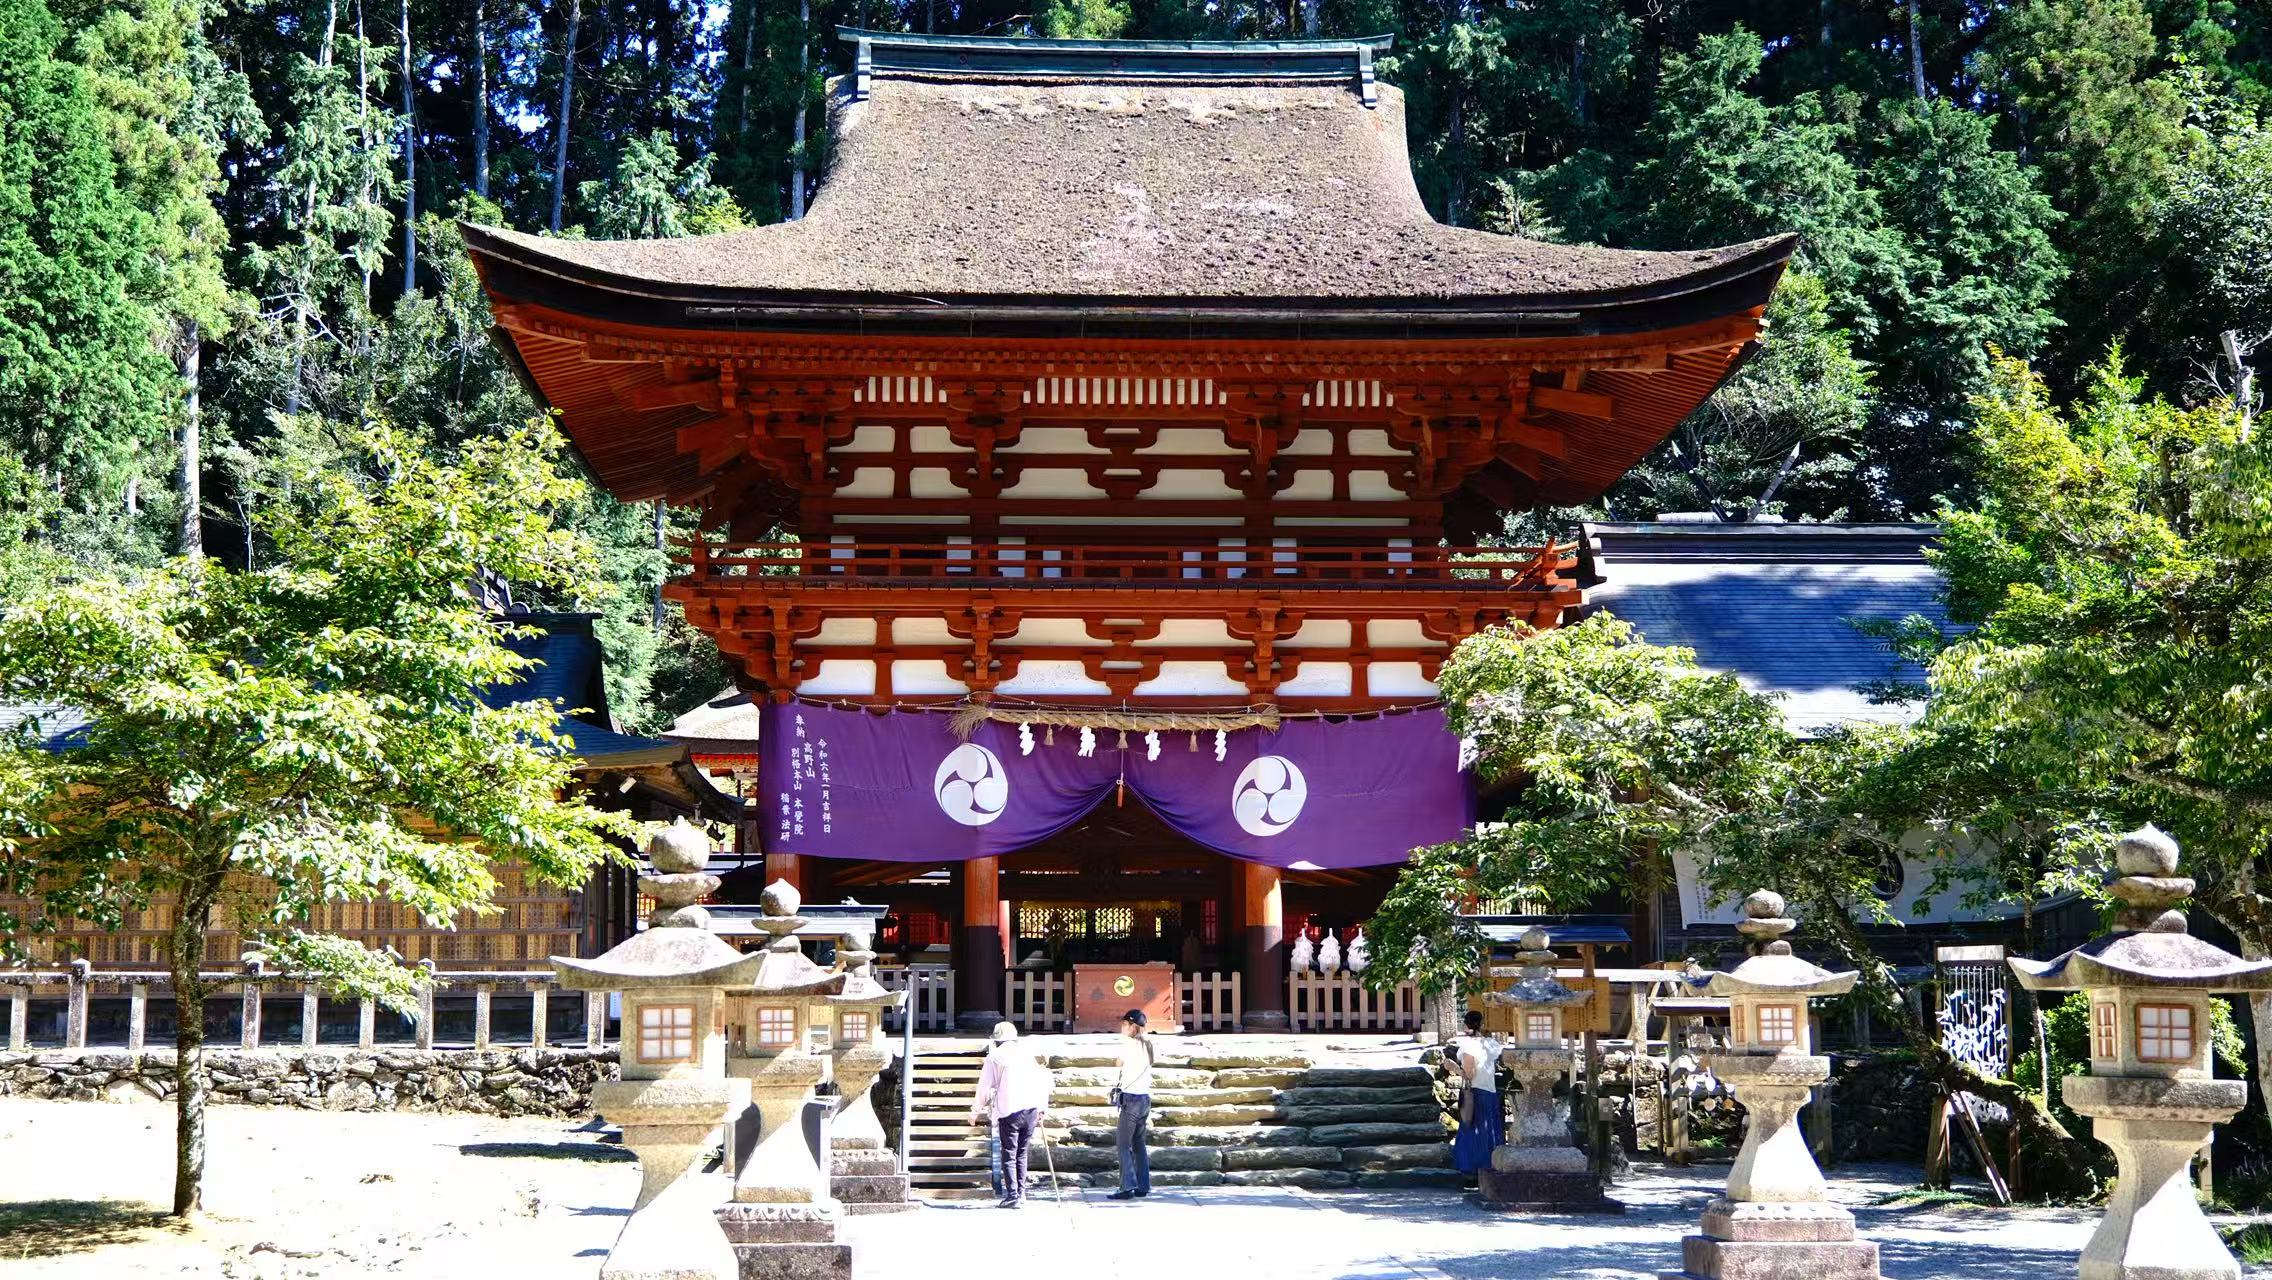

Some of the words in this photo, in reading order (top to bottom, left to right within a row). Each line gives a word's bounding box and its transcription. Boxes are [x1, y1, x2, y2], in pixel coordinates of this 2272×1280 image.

[795, 713, 805, 738] 奉納
[791, 747, 803, 790] 別格本山
[803, 741, 816, 779] 高野山
[817, 738, 831, 833] 令和六年一月吉祥日
